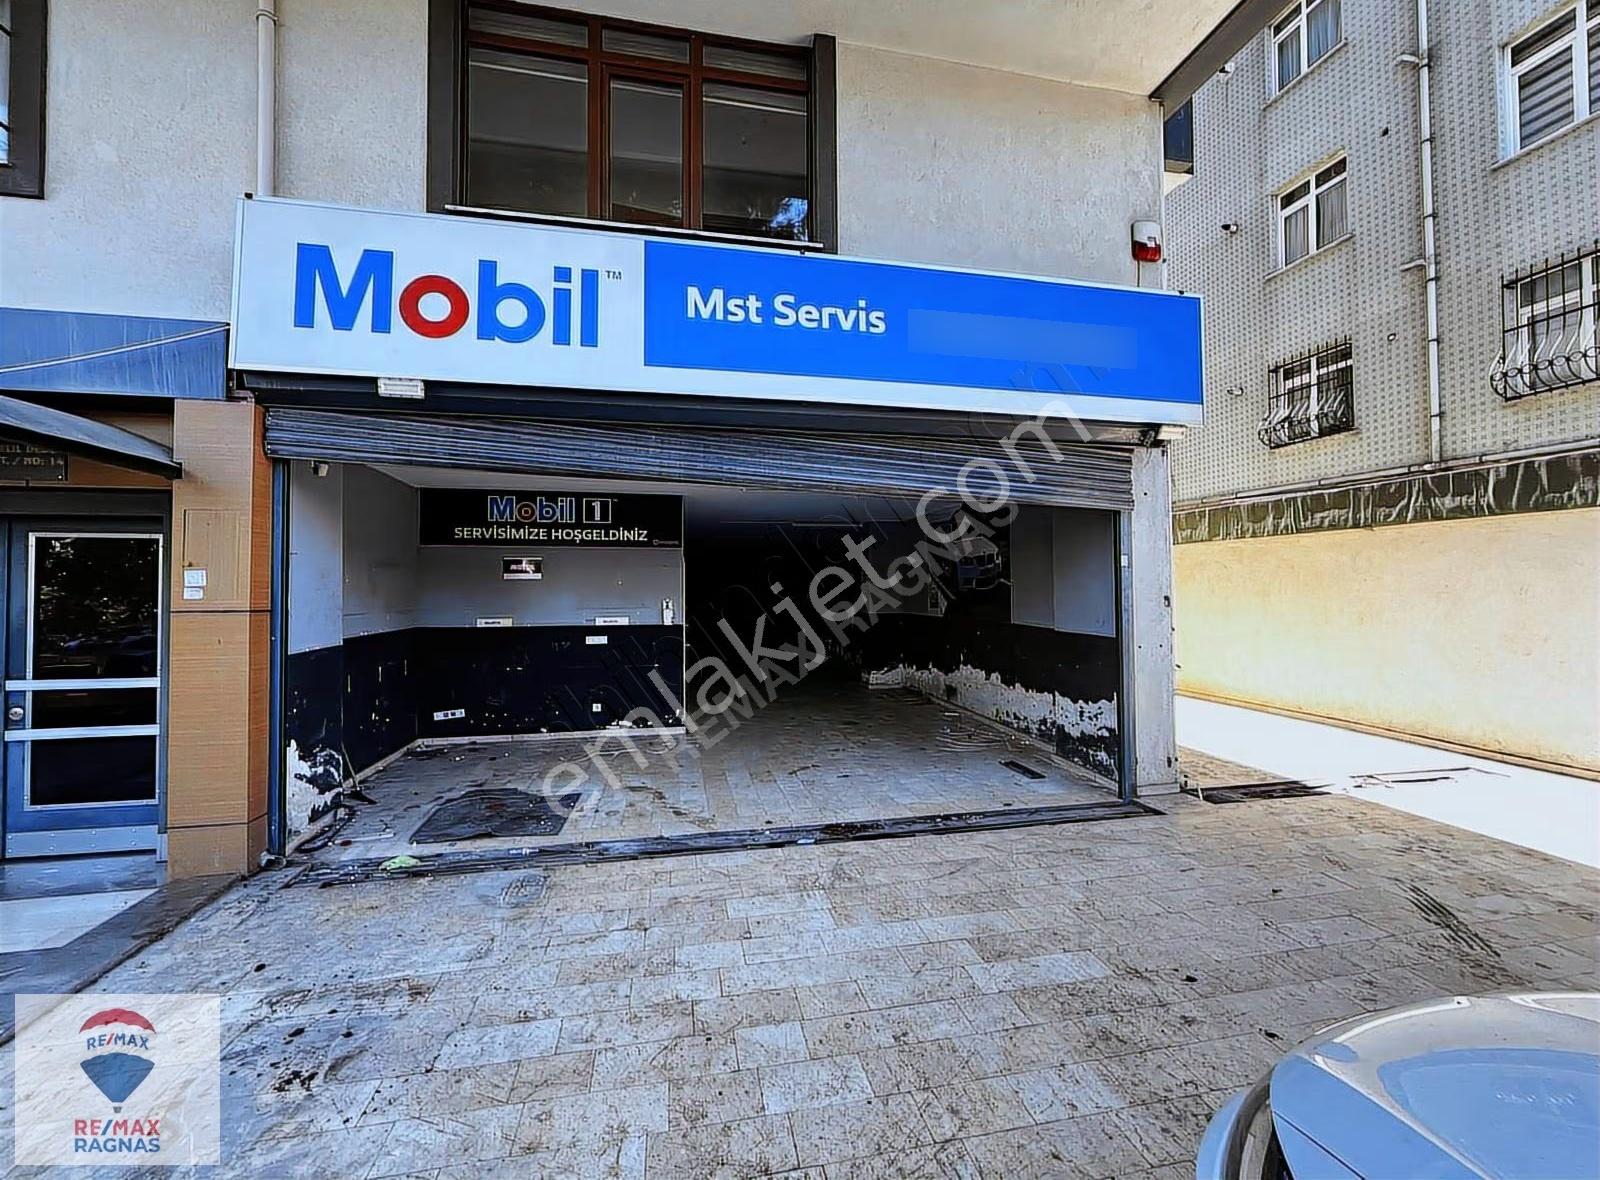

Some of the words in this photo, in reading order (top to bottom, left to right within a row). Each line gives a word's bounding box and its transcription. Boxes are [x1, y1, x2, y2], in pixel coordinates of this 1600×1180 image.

[293, 242, 599, 348] Mobil
[686, 285, 763, 324] Mst
[773, 293, 887, 334] Servis
[487, 495, 576, 523] Mobil
[454, 525, 548, 540] SERVİSİMİZE
[551, 527, 648, 544] HOŞGELDİNİZ
